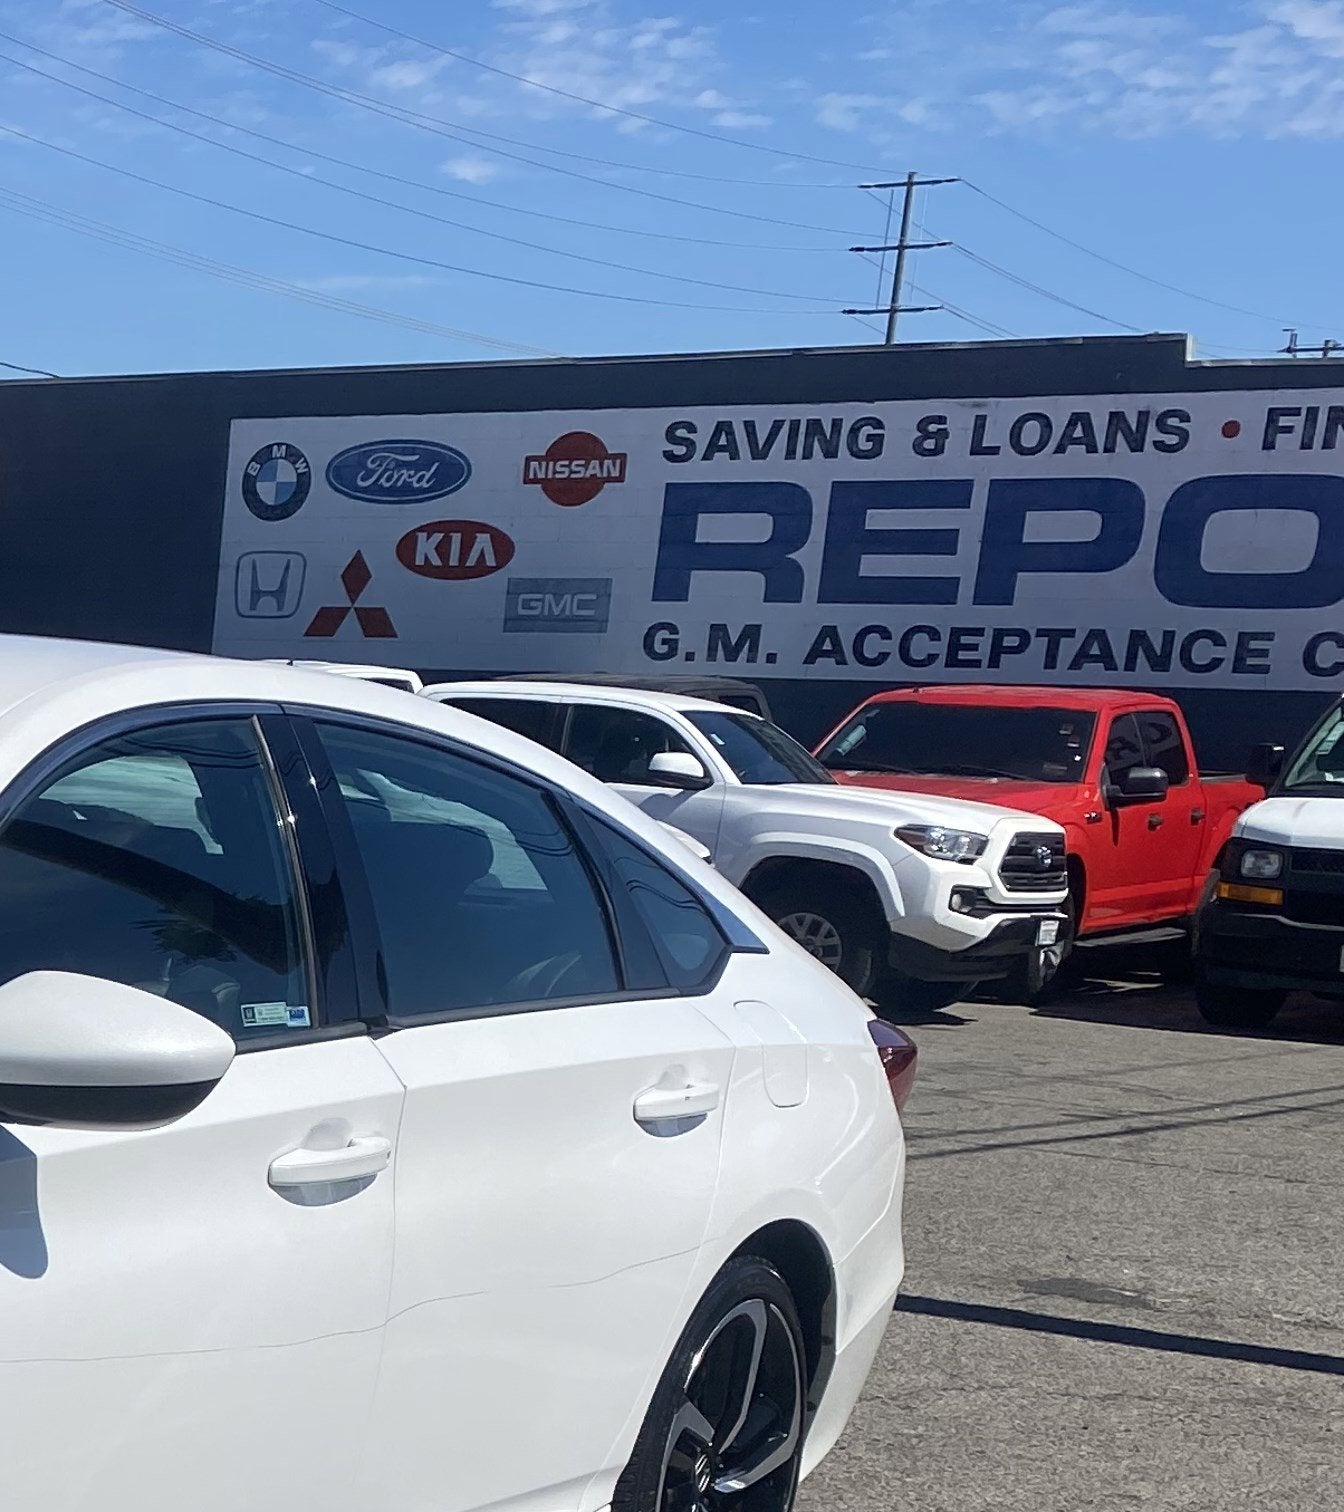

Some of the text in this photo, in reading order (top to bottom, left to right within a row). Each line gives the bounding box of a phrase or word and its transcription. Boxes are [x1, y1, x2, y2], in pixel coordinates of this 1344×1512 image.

[662, 416, 886, 464] SAVING
[912, 414, 950, 458] &
[969, 408, 1192, 457] LOANS
[246, 444, 309, 477] BMW
[356, 452, 440, 489] Ford
[528, 459, 622, 481] NISSAN
[415, 532, 497, 568] KIA
[651, 473, 1344, 610] REPO
[517, 593, 597, 618] GMC
[642, 621, 778, 665] G.M.
[802, 624, 1275, 676] ACCEPTANCE
